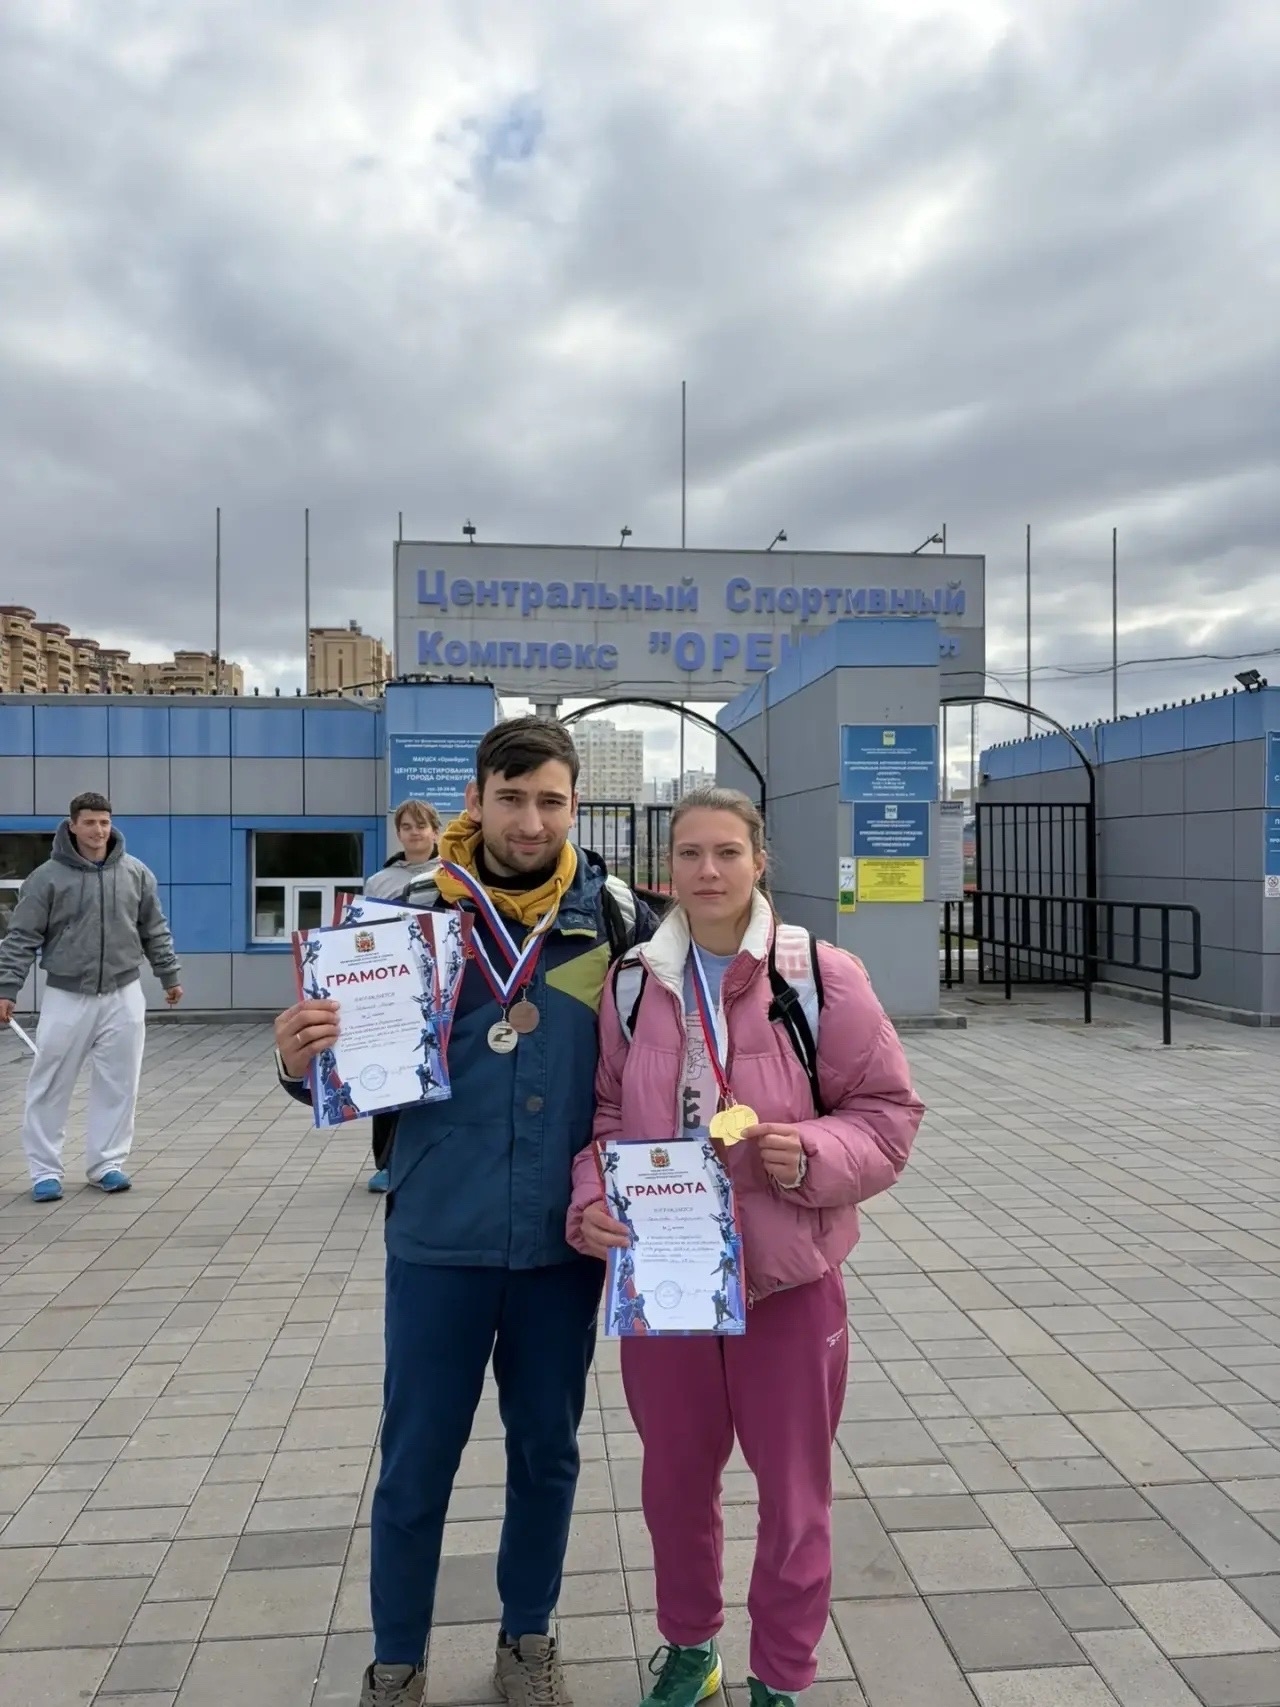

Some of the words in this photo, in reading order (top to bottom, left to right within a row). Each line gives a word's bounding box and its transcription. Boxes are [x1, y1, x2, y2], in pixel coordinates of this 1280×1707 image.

[417, 569, 699, 617] Центральный
[726, 578, 966, 621] Спортивный
[417, 630, 619, 668] Комплекс
[326, 964, 411, 988] ГРАМОТА
[626, 1182, 707, 1196] ГРАМОТА
